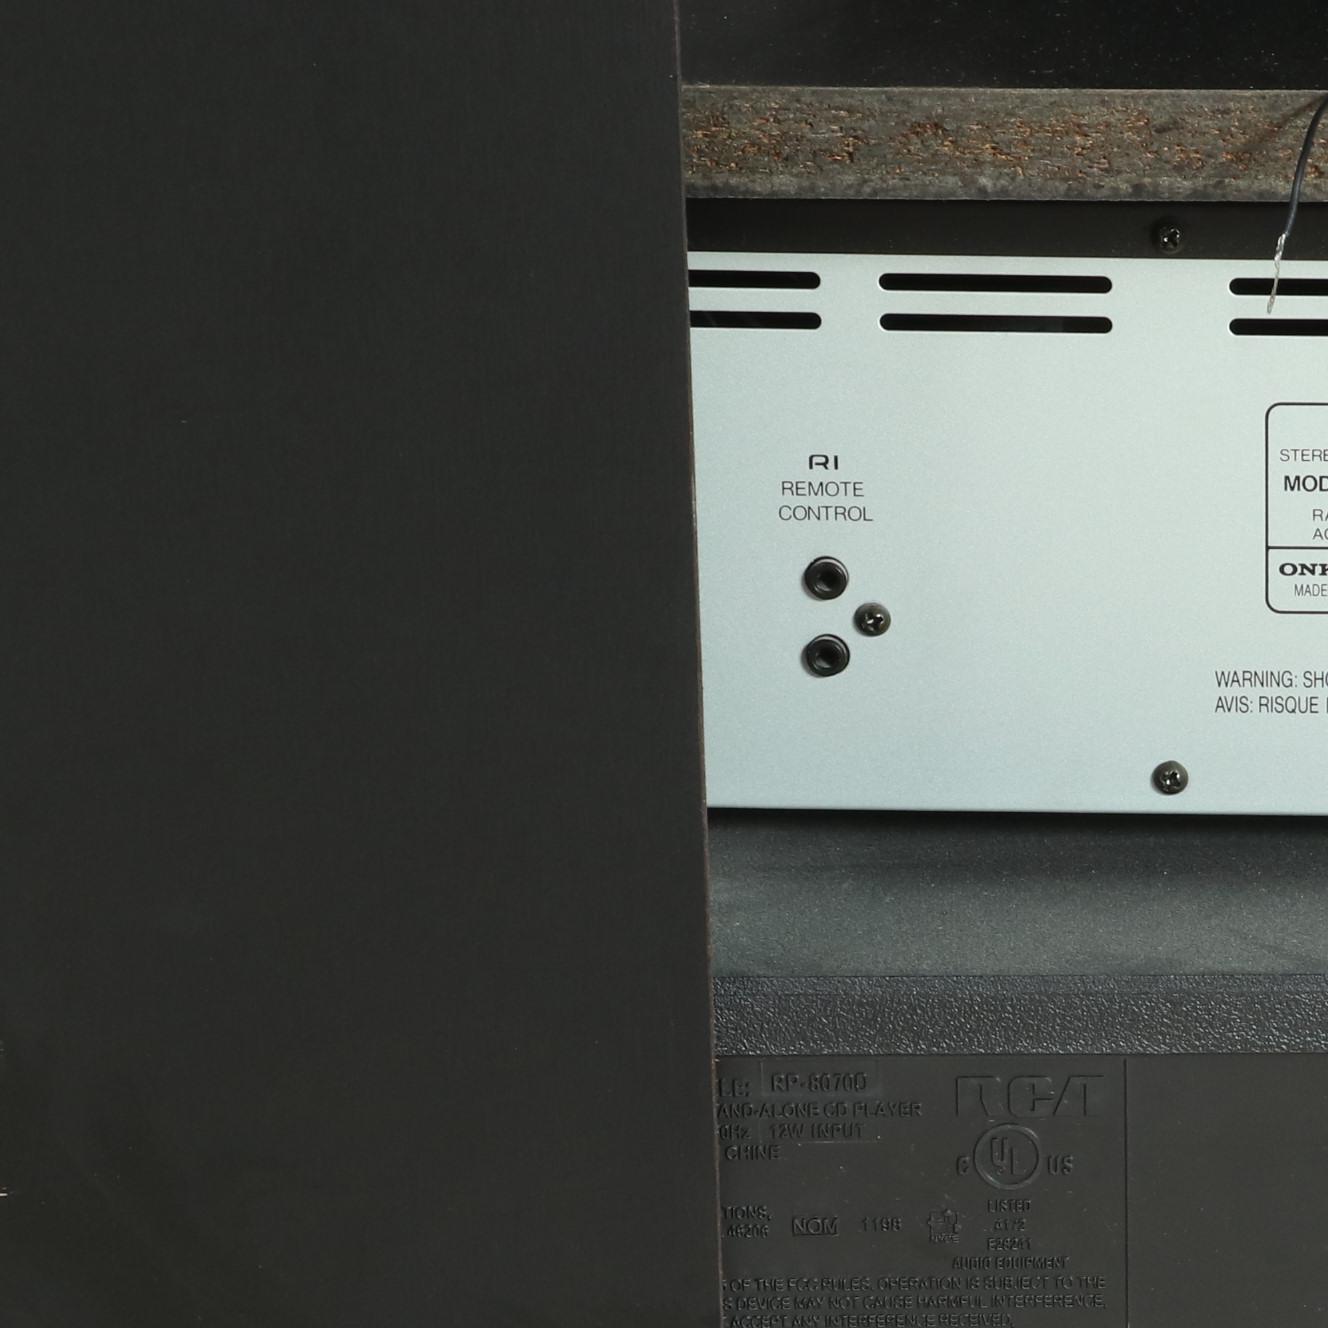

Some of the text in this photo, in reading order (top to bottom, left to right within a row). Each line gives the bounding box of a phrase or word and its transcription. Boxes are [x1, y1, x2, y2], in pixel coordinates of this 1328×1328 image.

[809, 454, 839, 470] RI
[781, 481, 864, 496] REMOTE
[779, 505, 874, 521] CONTROL
[1294, 584, 1328, 597] MADE
[1215, 671, 1298, 689] WARNING:
[1215, 696, 1254, 714] AVIS:
[1258, 696, 1319, 714] RISQUE
[954, 1074, 1105, 1118] RCA
[853, 1102, 923, 1118] PLAYER
[1047, 1156, 1074, 1175] US
[793, 1218, 839, 1235] NOM
